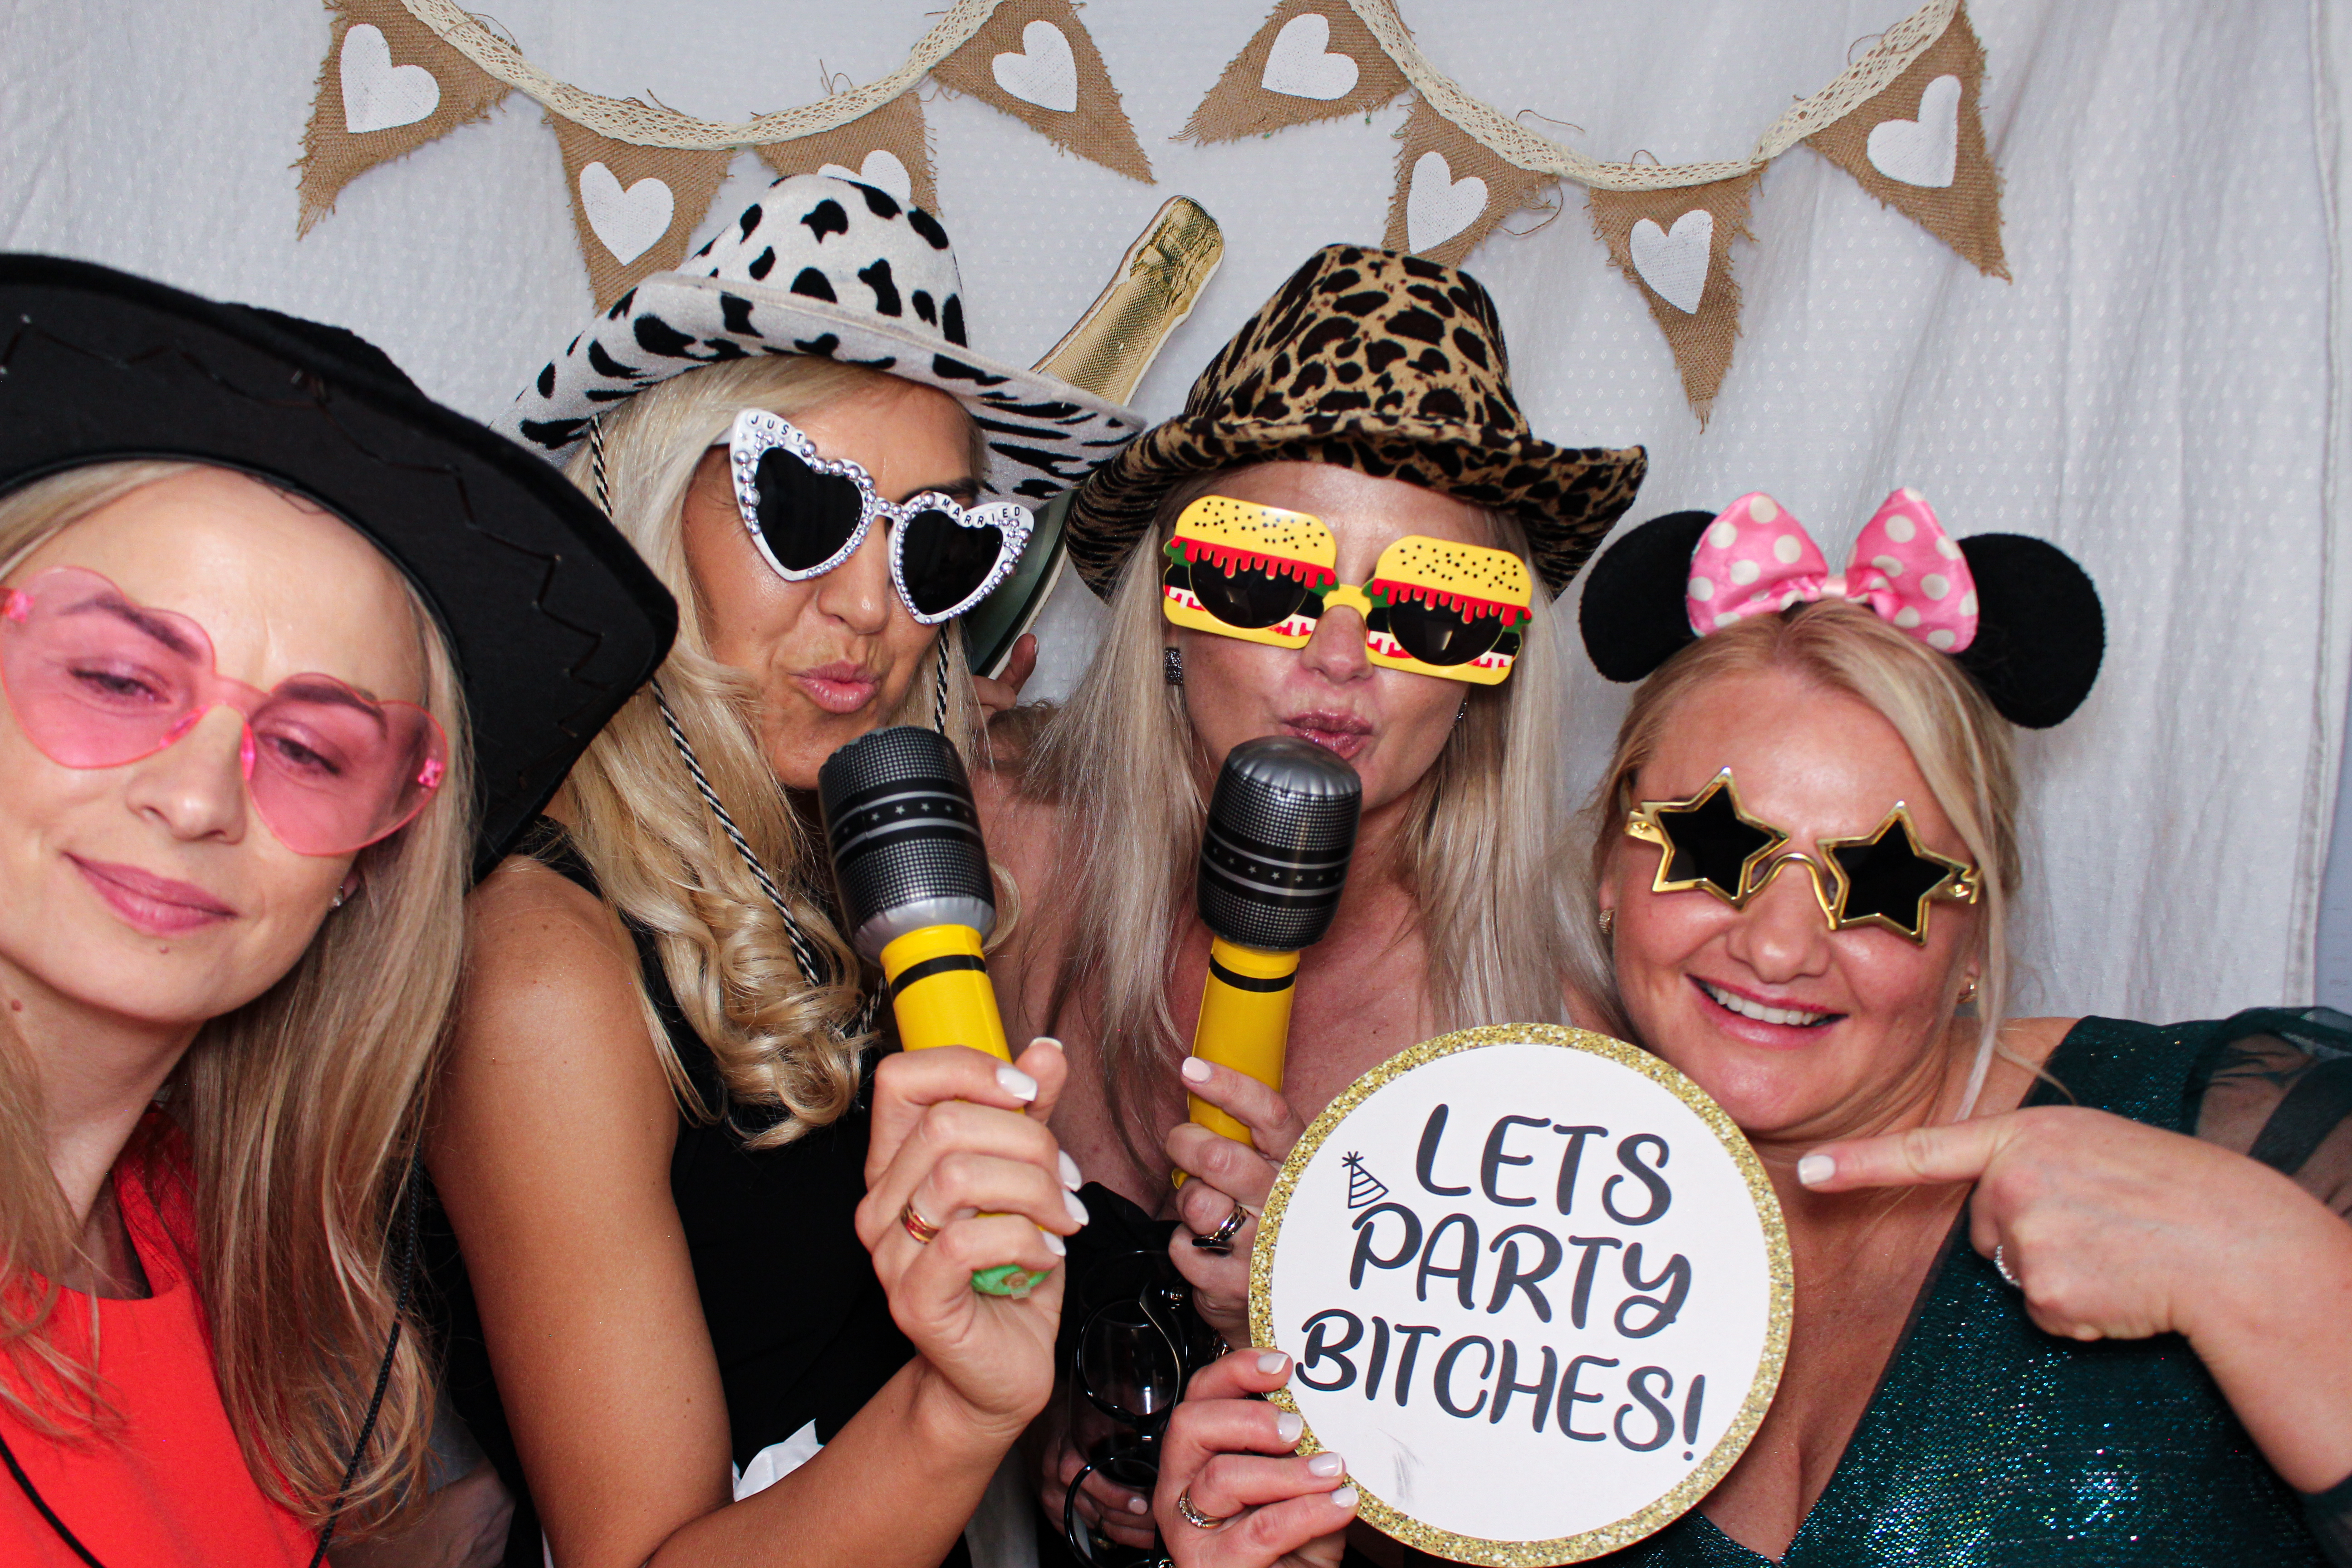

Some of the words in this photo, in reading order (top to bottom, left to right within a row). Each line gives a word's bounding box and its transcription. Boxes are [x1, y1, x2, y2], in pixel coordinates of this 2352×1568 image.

[750, 415, 803, 443] JUST
[941, 497, 1022, 526] MARRIED
[1416, 1103, 1671, 1226] LETS
[1350, 1202, 1691, 1338] PARTY
[1295, 1308, 1705, 1461] BITCHES!
